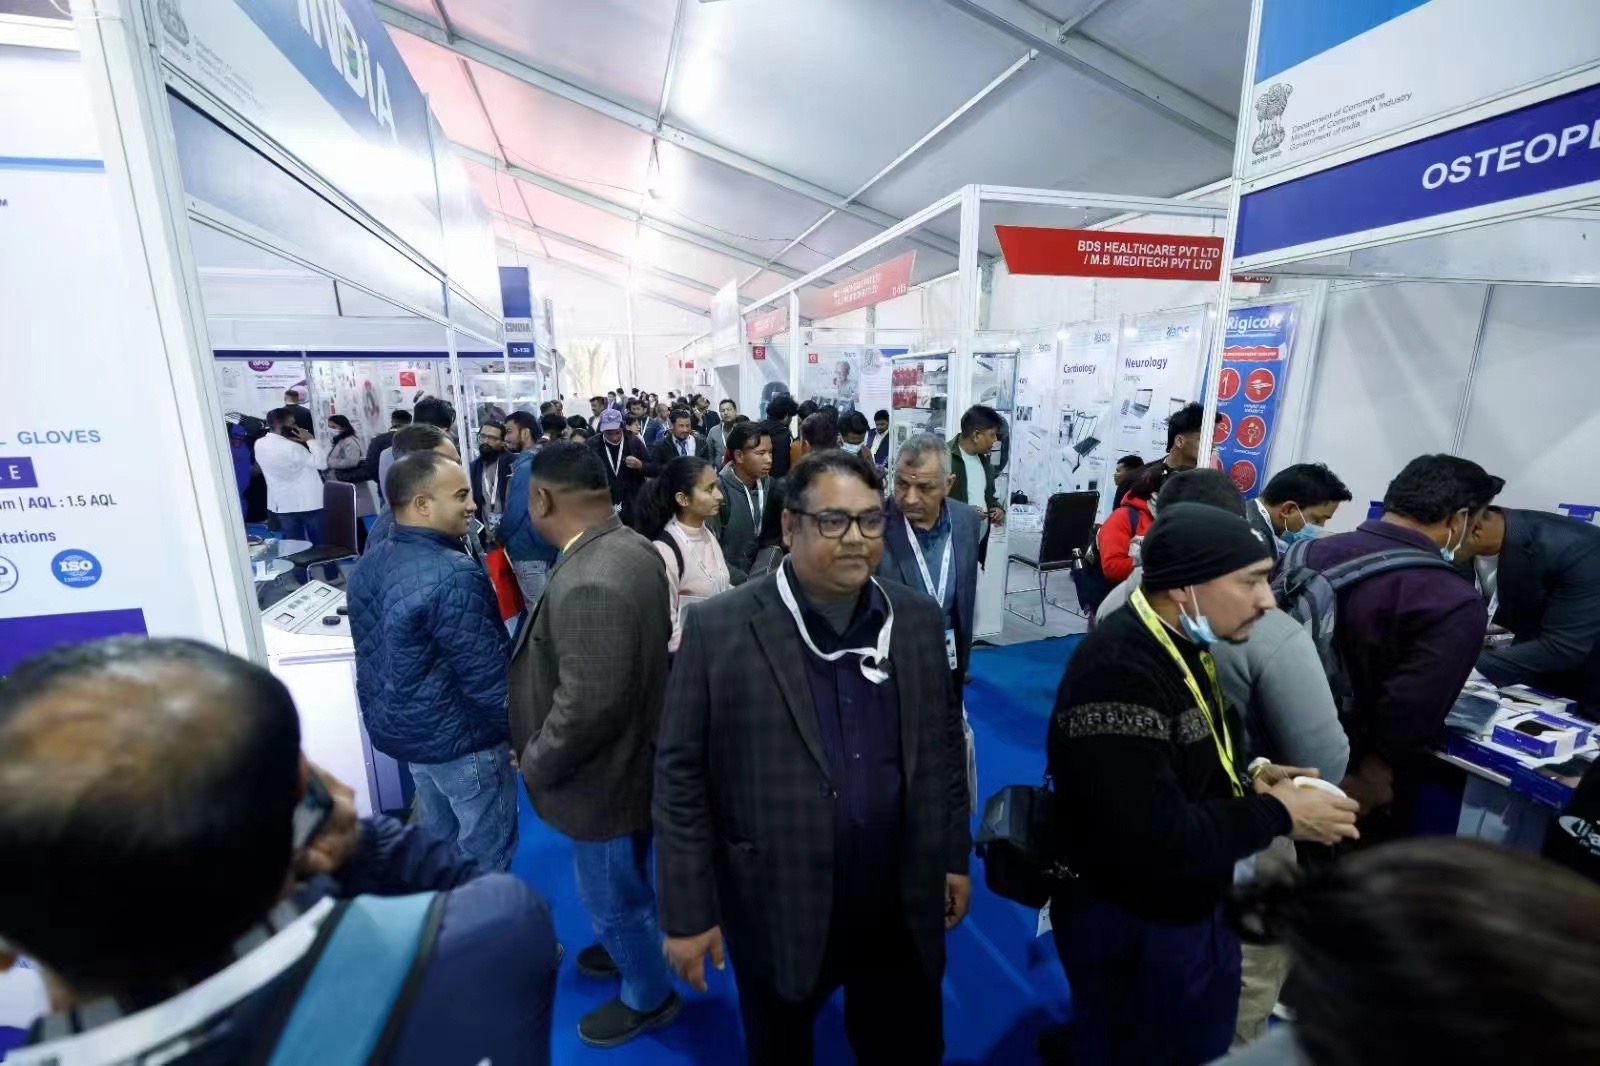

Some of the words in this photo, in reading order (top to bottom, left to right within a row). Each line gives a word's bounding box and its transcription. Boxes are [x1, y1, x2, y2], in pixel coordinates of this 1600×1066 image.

[1327, 109, 1368, 129] Commerce
[1370, 104, 1376, 113] &
[1379, 91, 1412, 111] Industry
[1343, 92, 1385, 114] Commerce
[1290, 131, 1331, 150] Government
[1342, 120, 1360, 133] India
[1077, 240, 1101, 252] BDS
[1104, 241, 1176, 257] HEALTHCARE
[1178, 245, 1199, 257] PVT
[1201, 247, 1220, 258] LTD
[1090, 254, 1111, 265] M.B
[1113, 255, 1168, 268] MEDITECH
[1170, 257, 1191, 269] PVT
[1193, 258, 1213, 270] LTD
[1063, 363, 1097, 375] Cardiology
[1125, 357, 1168, 370] Neurology
[17, 430, 101, 445] GLOVES
[28, 496, 56, 509] AQL
[67, 495, 87, 507] 1.5
[90, 494, 117, 507] AQL
[60, 560, 93, 572] ISO
